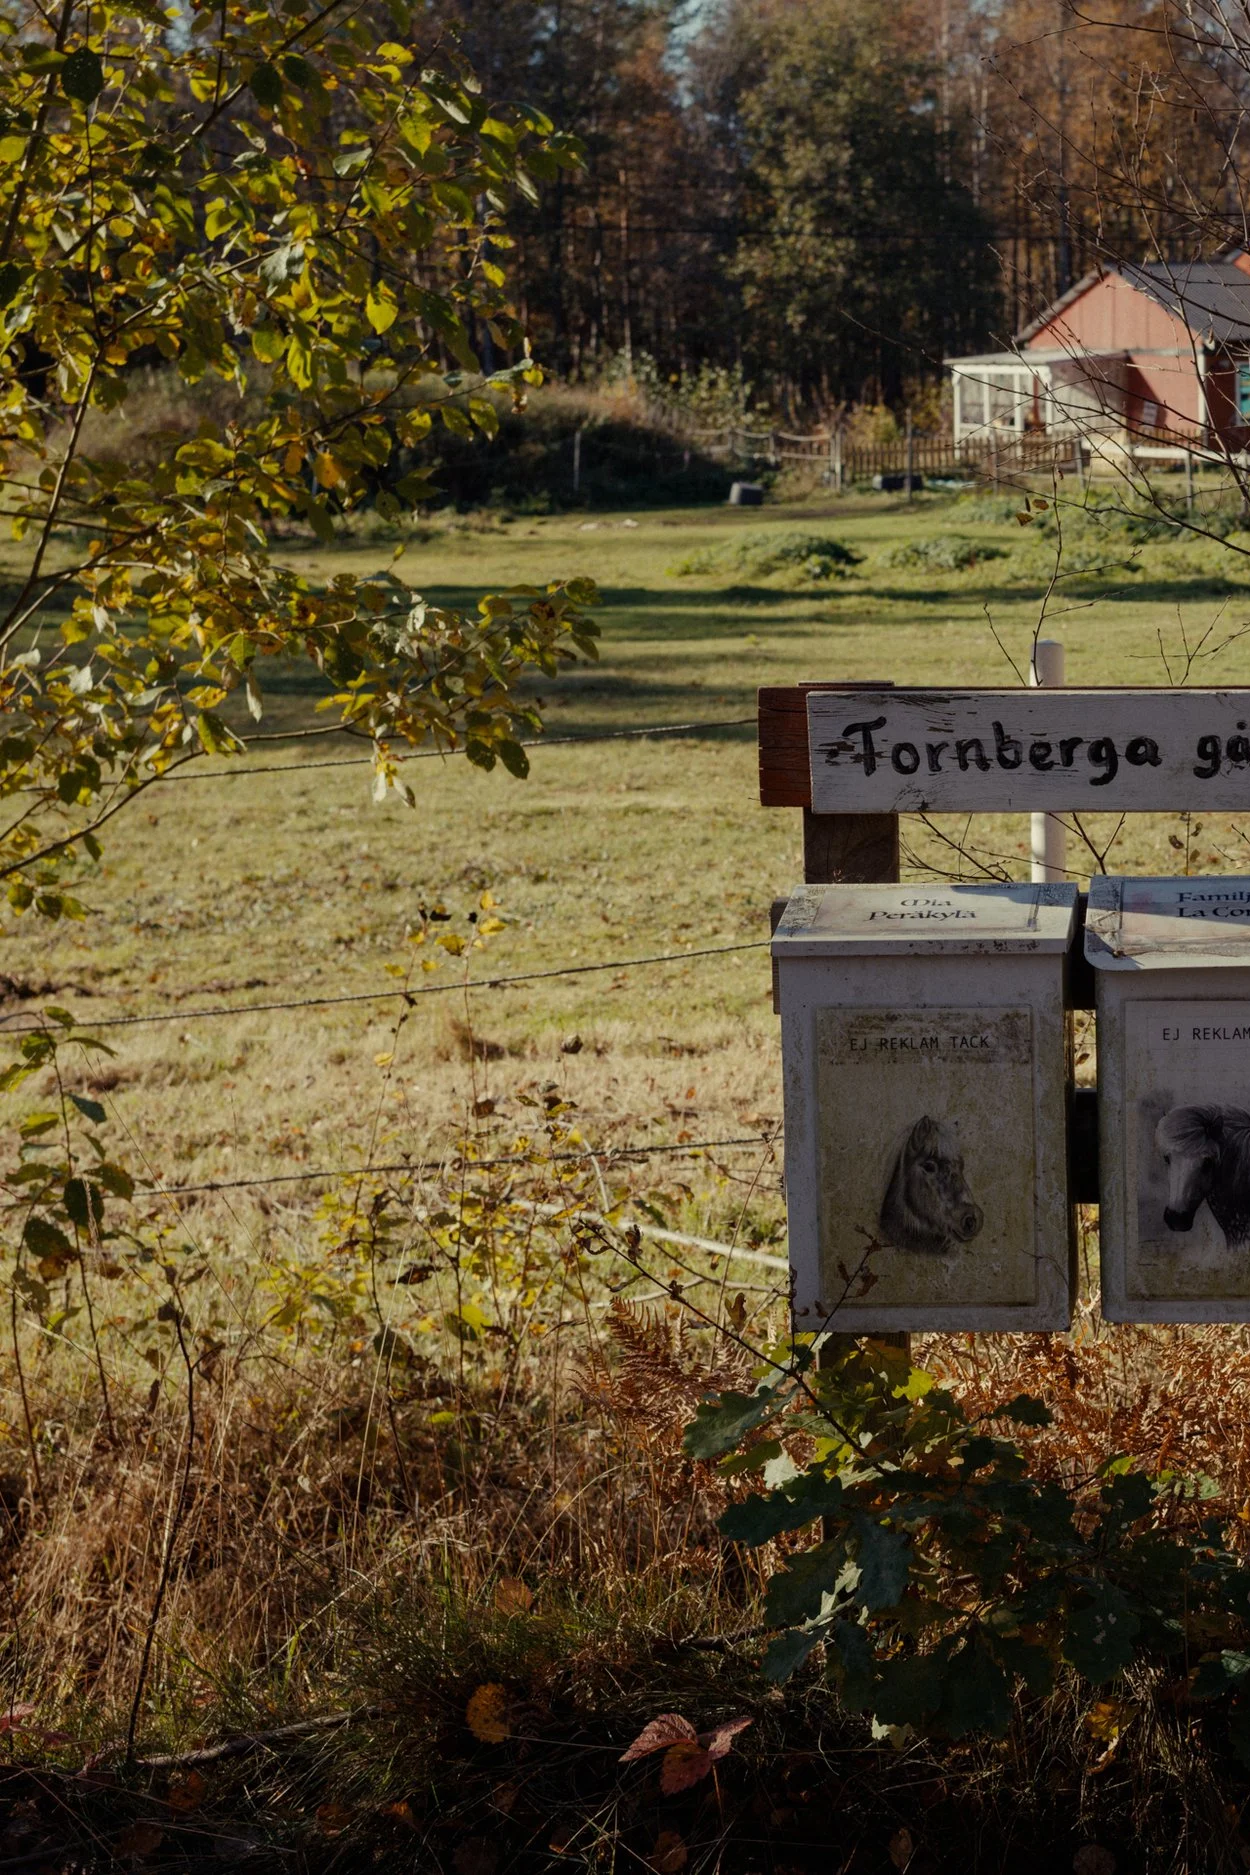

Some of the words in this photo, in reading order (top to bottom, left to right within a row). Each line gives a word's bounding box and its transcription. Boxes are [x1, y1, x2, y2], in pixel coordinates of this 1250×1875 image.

[842, 716, 1163, 787] Tornberga
[866, 910, 977, 922] Peräkylä
[1177, 907, 1206, 918] La
[1162, 1028, 1180, 1041] EJ
[850, 1038, 868, 1051] EJ
[880, 1037, 939, 1050] REKLAM
[950, 1035, 991, 1049] TACK
